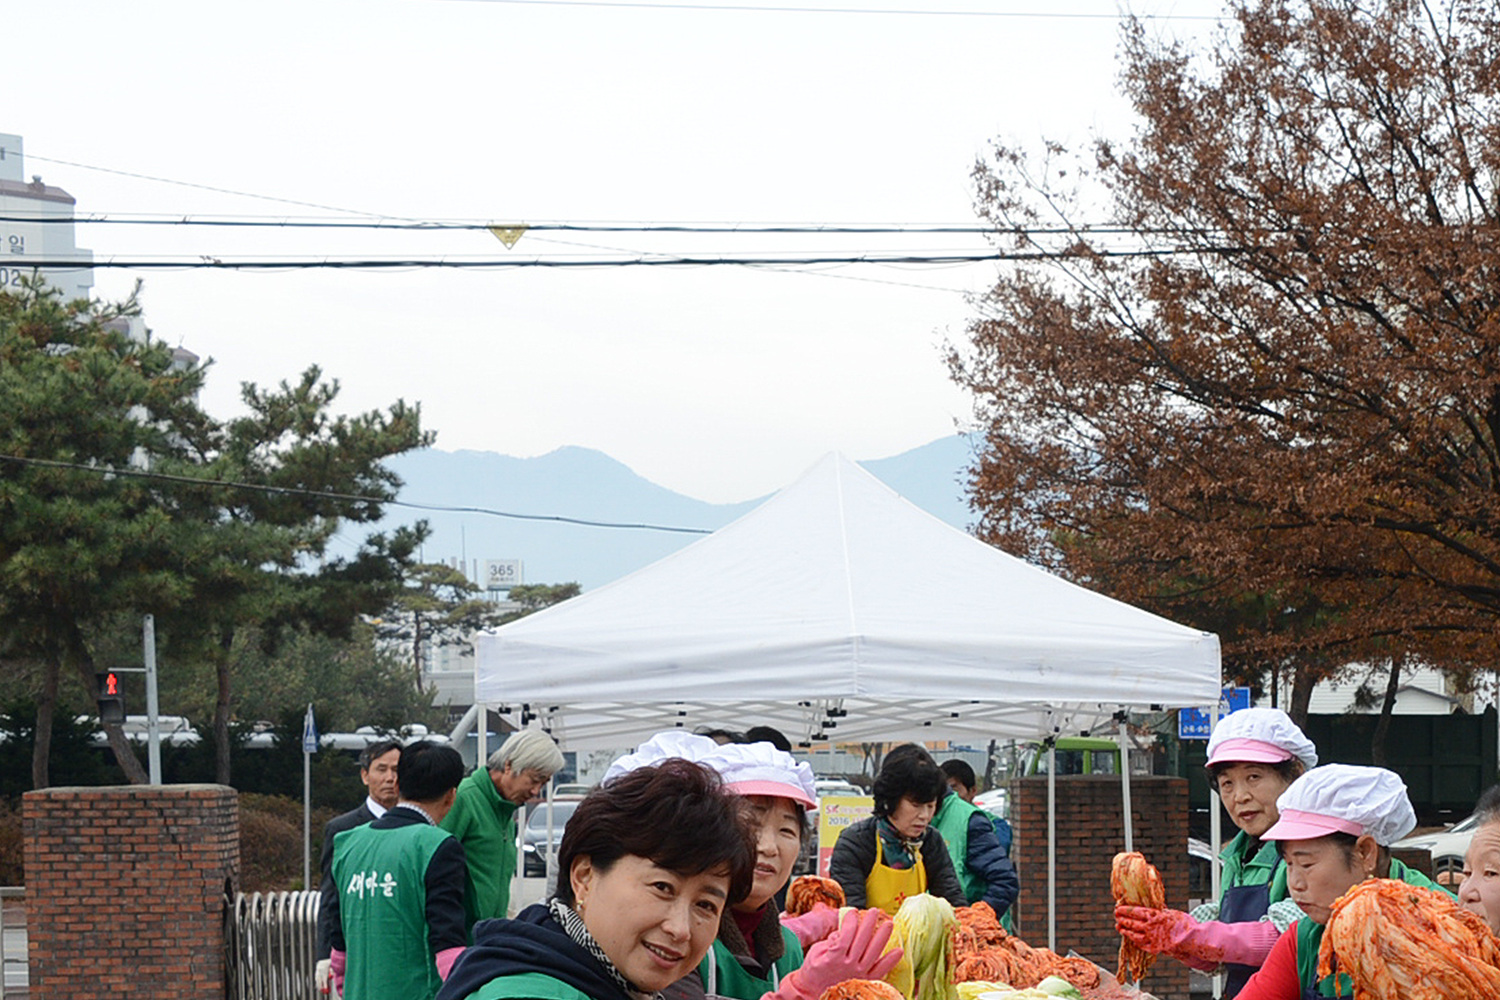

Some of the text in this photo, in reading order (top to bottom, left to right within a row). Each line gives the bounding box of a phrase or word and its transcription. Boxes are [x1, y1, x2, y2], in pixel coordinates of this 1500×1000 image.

[490, 564, 514, 576] 365
[828, 817, 849, 826] 2016
[347, 871, 397, 900] 새마을
